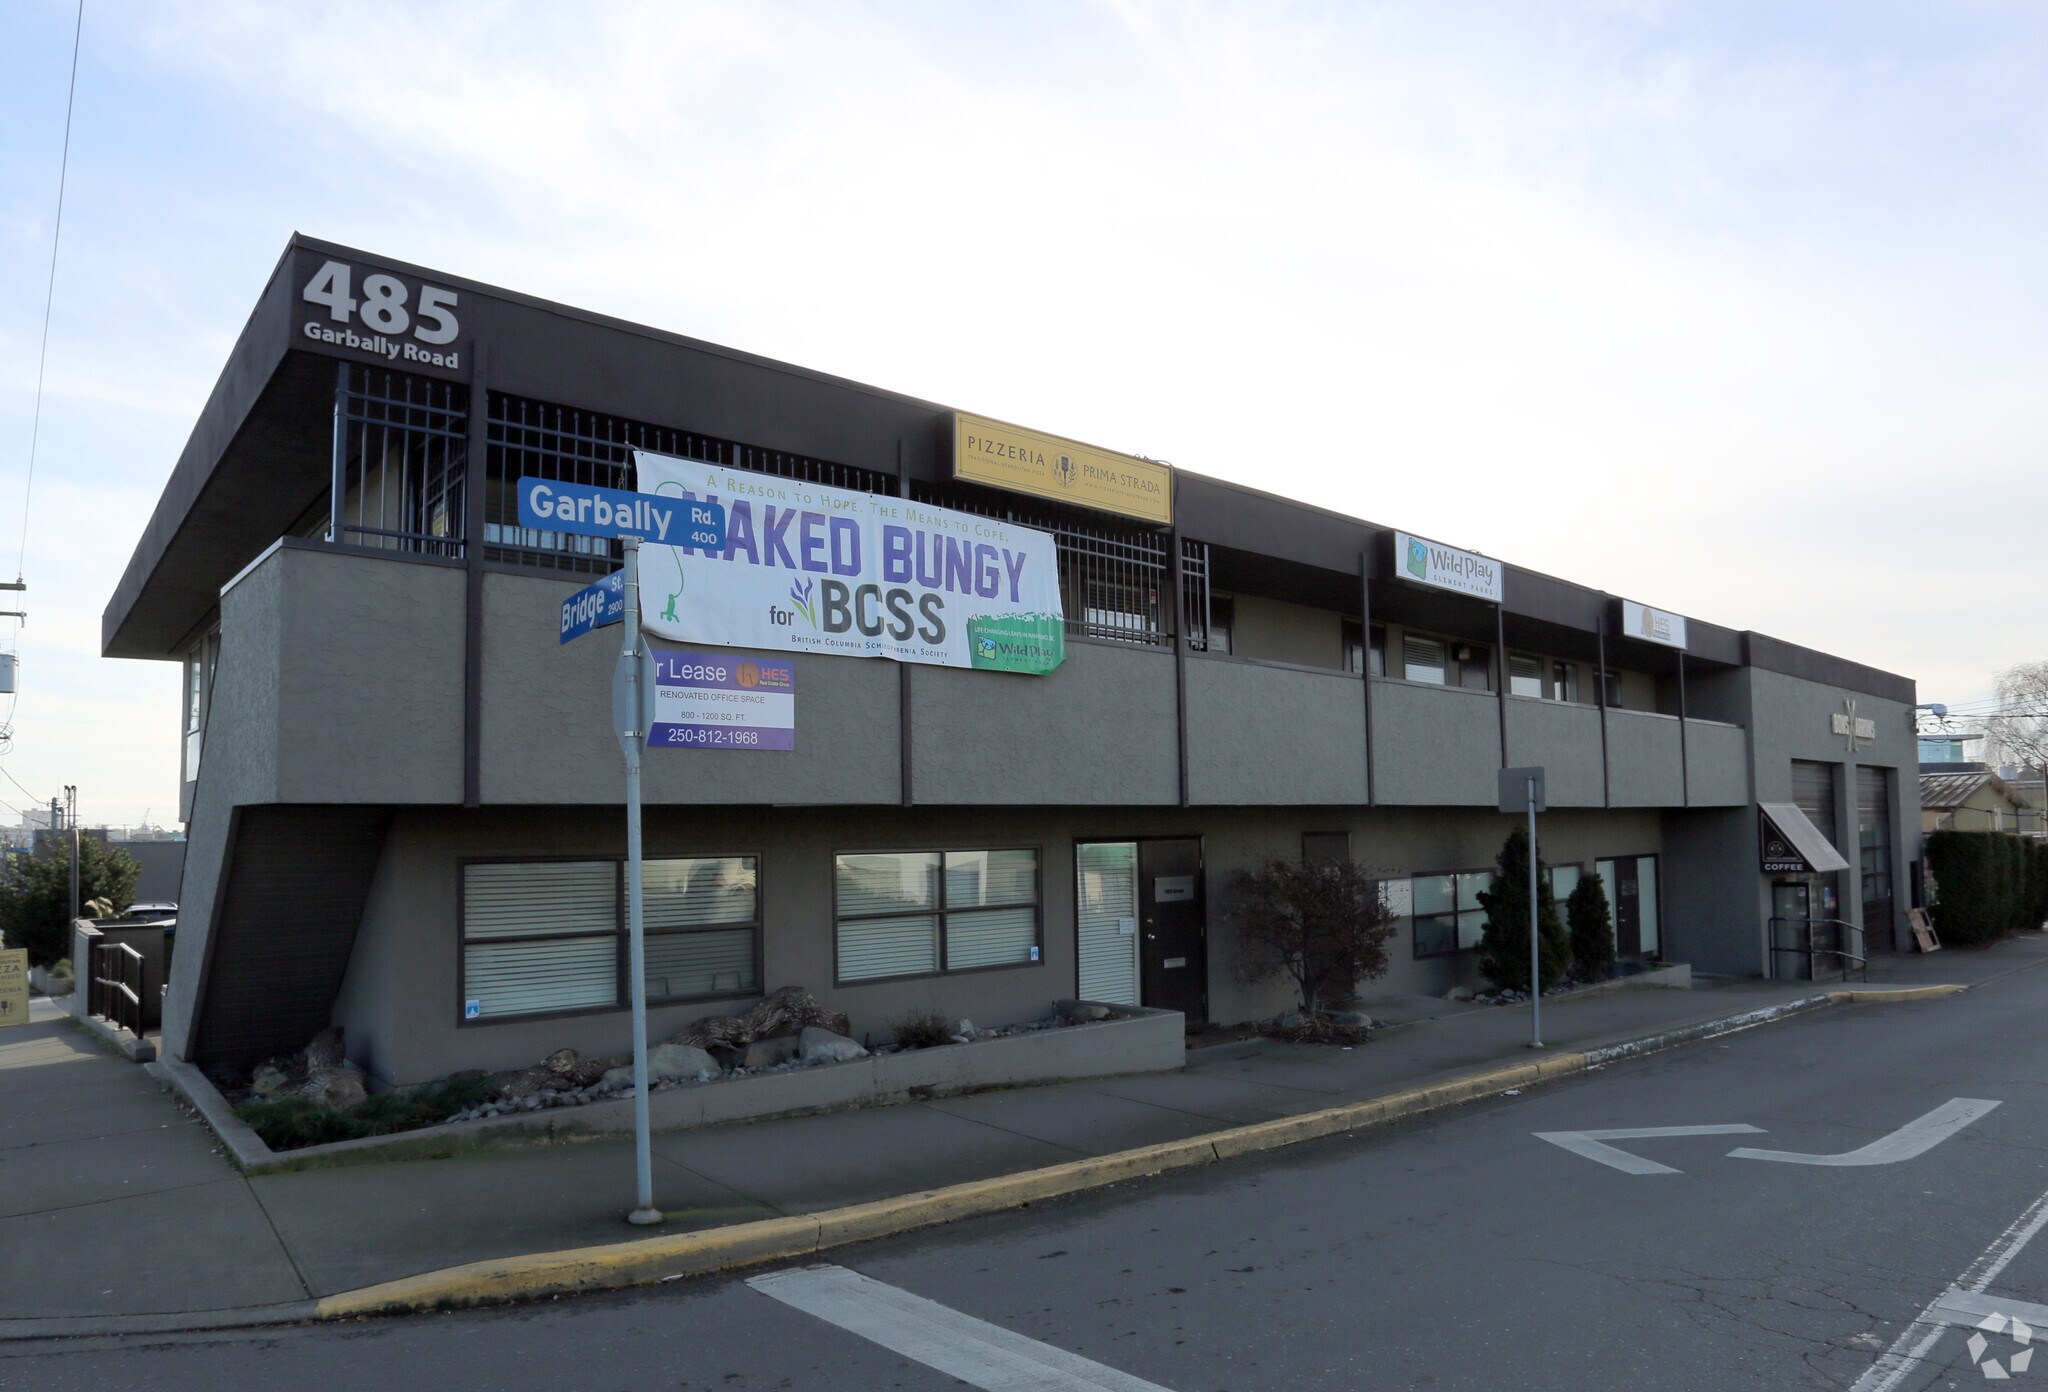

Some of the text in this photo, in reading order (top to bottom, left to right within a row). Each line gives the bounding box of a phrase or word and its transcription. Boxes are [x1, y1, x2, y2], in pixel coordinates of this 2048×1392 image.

[303, 260, 459, 345] 485
[303, 322, 459, 369] Garbally Road
[968, 436, 1045, 466] PIZZERIA
[706, 474, 717, 488] A
[1083, 464, 1161, 494] PRIMA STRADA
[529, 485, 673, 540] Garbally
[691, 507, 716, 526] Rd.
[691, 531, 717, 544] 400
[883, 524, 1027, 603] BUNGY
[1433, 574, 1493, 595] ELEMENT PARKS
[560, 589, 605, 634] Bridge
[608, 598, 624, 615] 2900
[769, 578, 947, 645] for BCSS
[669, 658, 727, 682] Lease
[761, 667, 790, 681] HES
[660, 690, 765, 704] RENOVATED OFFICE SPACE
[681, 711, 695, 719] 800
[702, 712, 719, 720] 1200
[720, 713, 734, 722] SQ.
[668, 728, 758, 745] 250-812-1968
[1764, 863, 1803, 871] COFFEE
